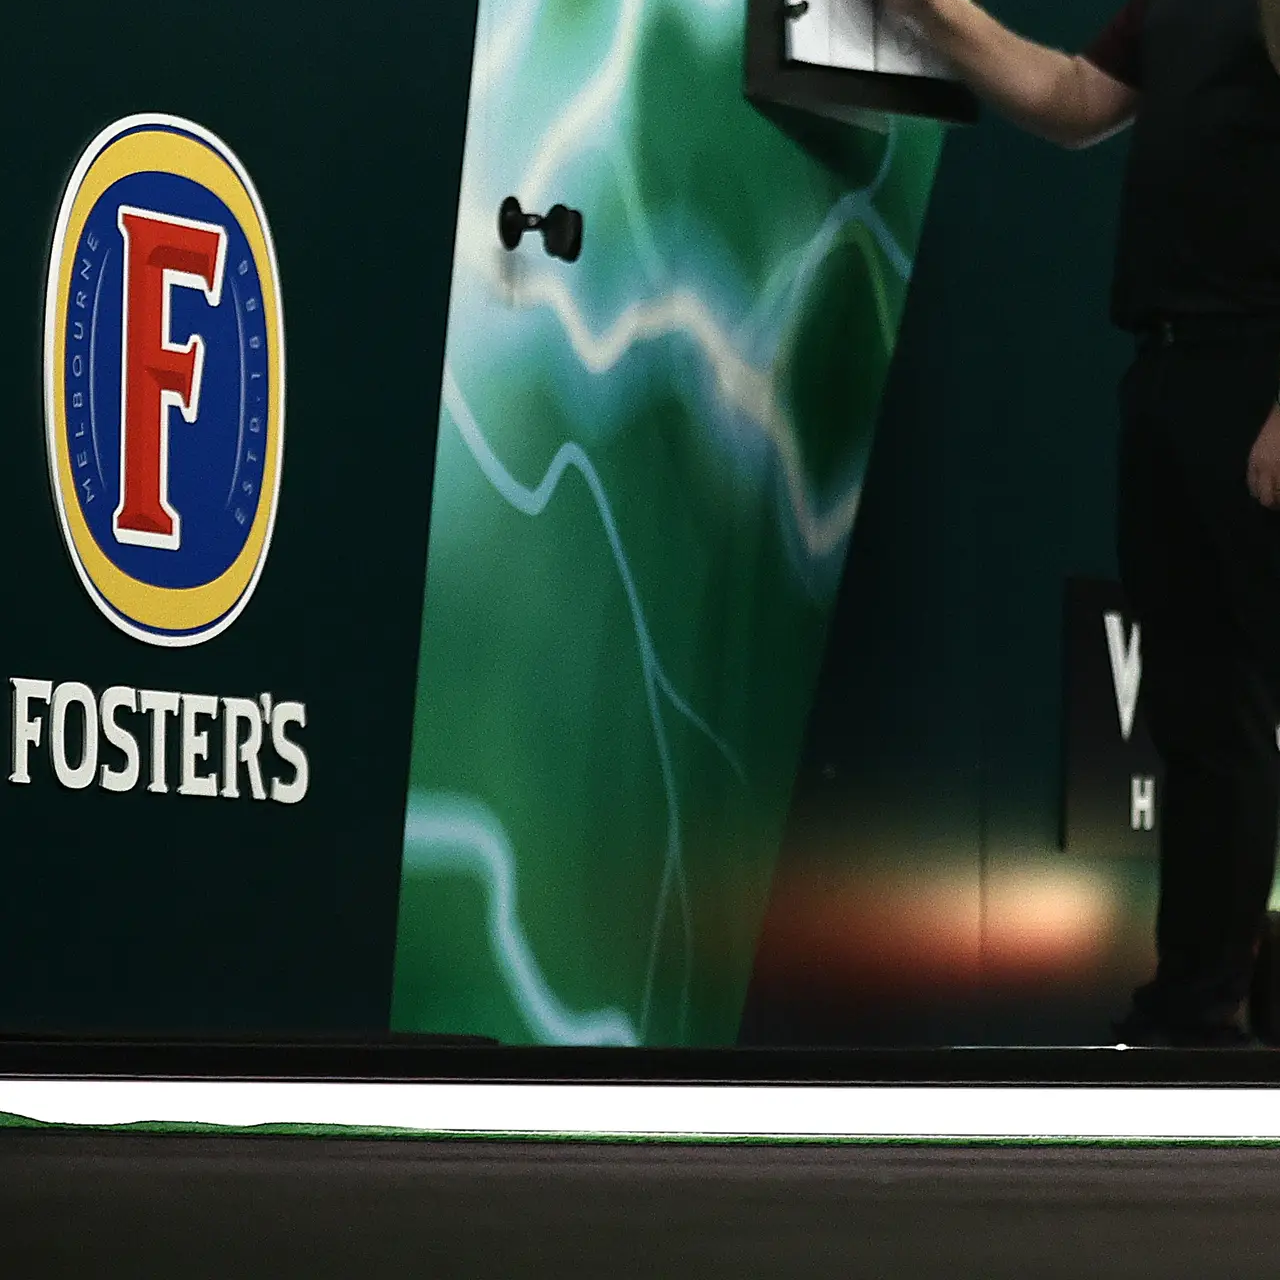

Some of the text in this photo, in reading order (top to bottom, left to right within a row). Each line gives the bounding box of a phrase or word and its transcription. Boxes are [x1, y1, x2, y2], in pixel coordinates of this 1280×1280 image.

[72, 232, 100, 505] MELBOURNE
[113, 205, 228, 551] F
[8, 677, 309, 805] FOSTER'S
